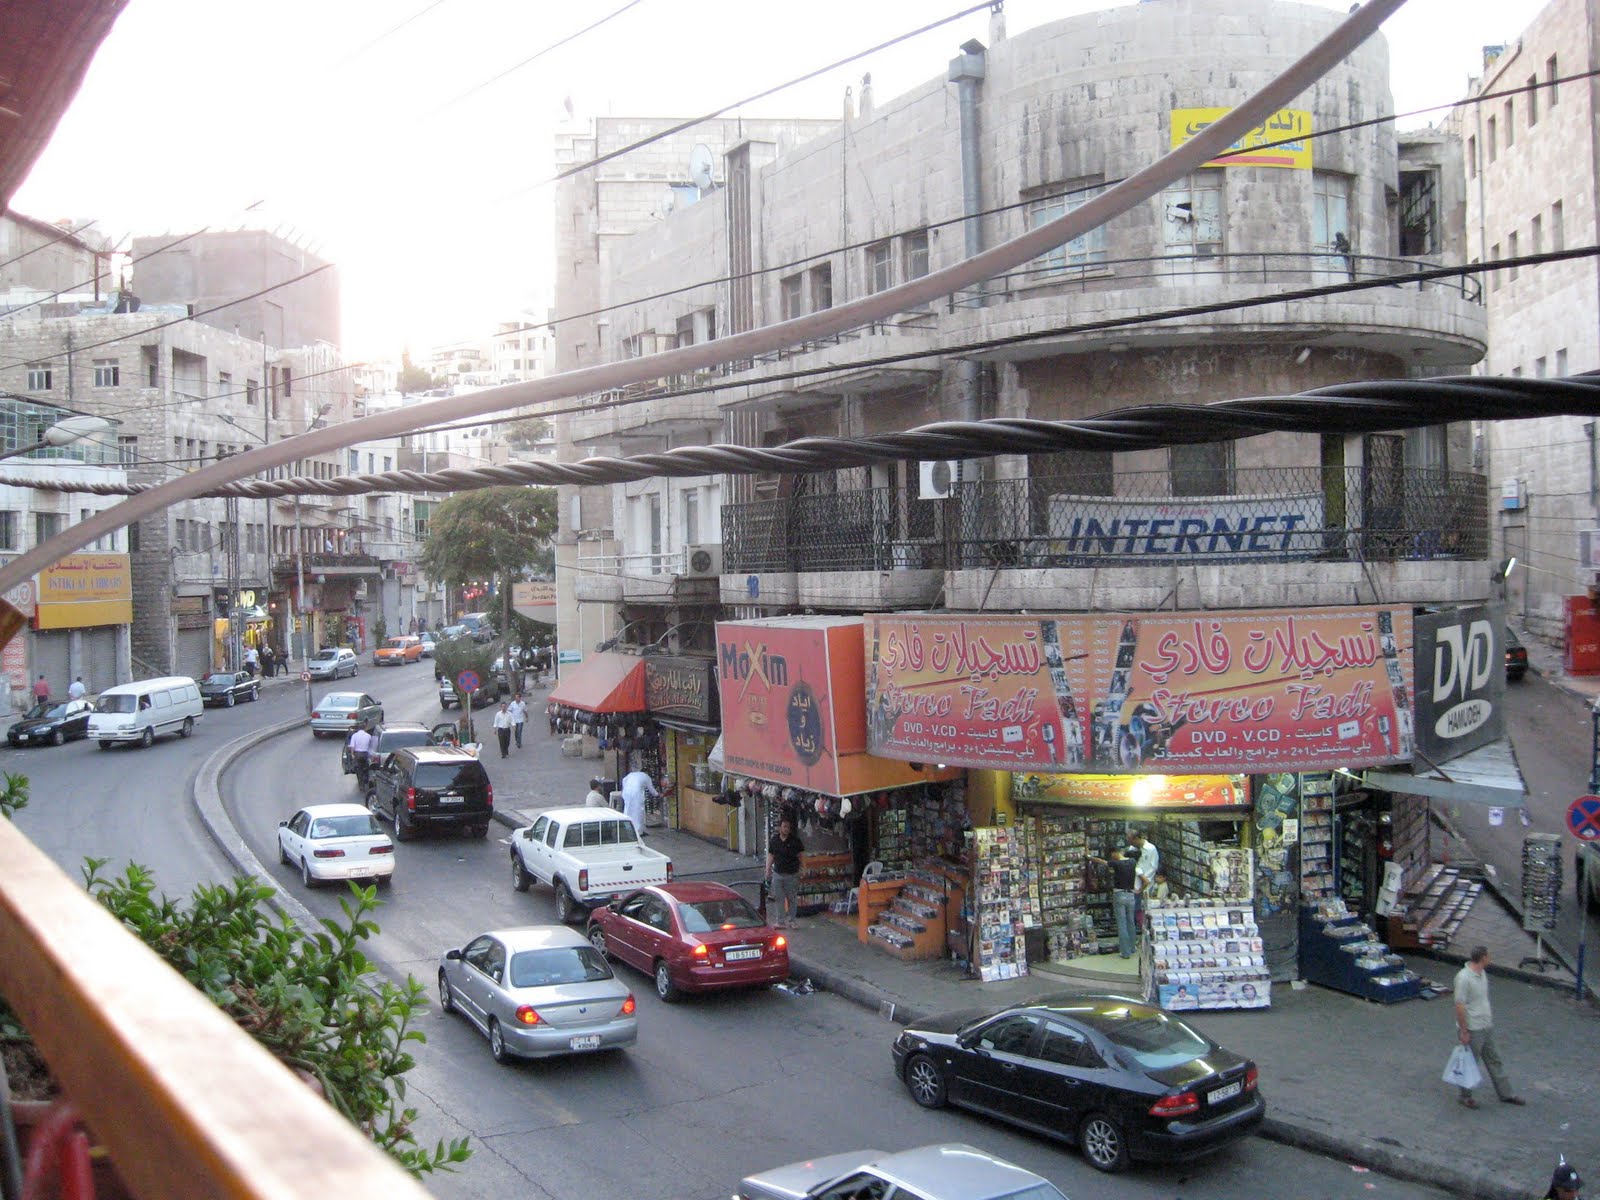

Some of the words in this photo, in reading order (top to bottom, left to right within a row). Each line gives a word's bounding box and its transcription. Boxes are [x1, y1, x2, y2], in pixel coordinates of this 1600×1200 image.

[1068, 515, 1305, 552] INTERNET
[881, 621, 925, 676] فادي
[932, 622, 1041, 680] تسجيلات
[1140, 619, 1231, 684] فادي
[1243, 616, 1377, 679] تسجيلات
[1433, 620, 1493, 703] DVD
[881, 682, 952, 716] Stereo
[960, 686, 1038, 722] Fadi
[1142, 688, 1275, 726] Stereo
[1285, 680, 1376, 721] Fadi
[903, 721, 923, 734] DVD
[1191, 730, 1227, 744] DVD
[1242, 729, 1281, 742] V.CD
